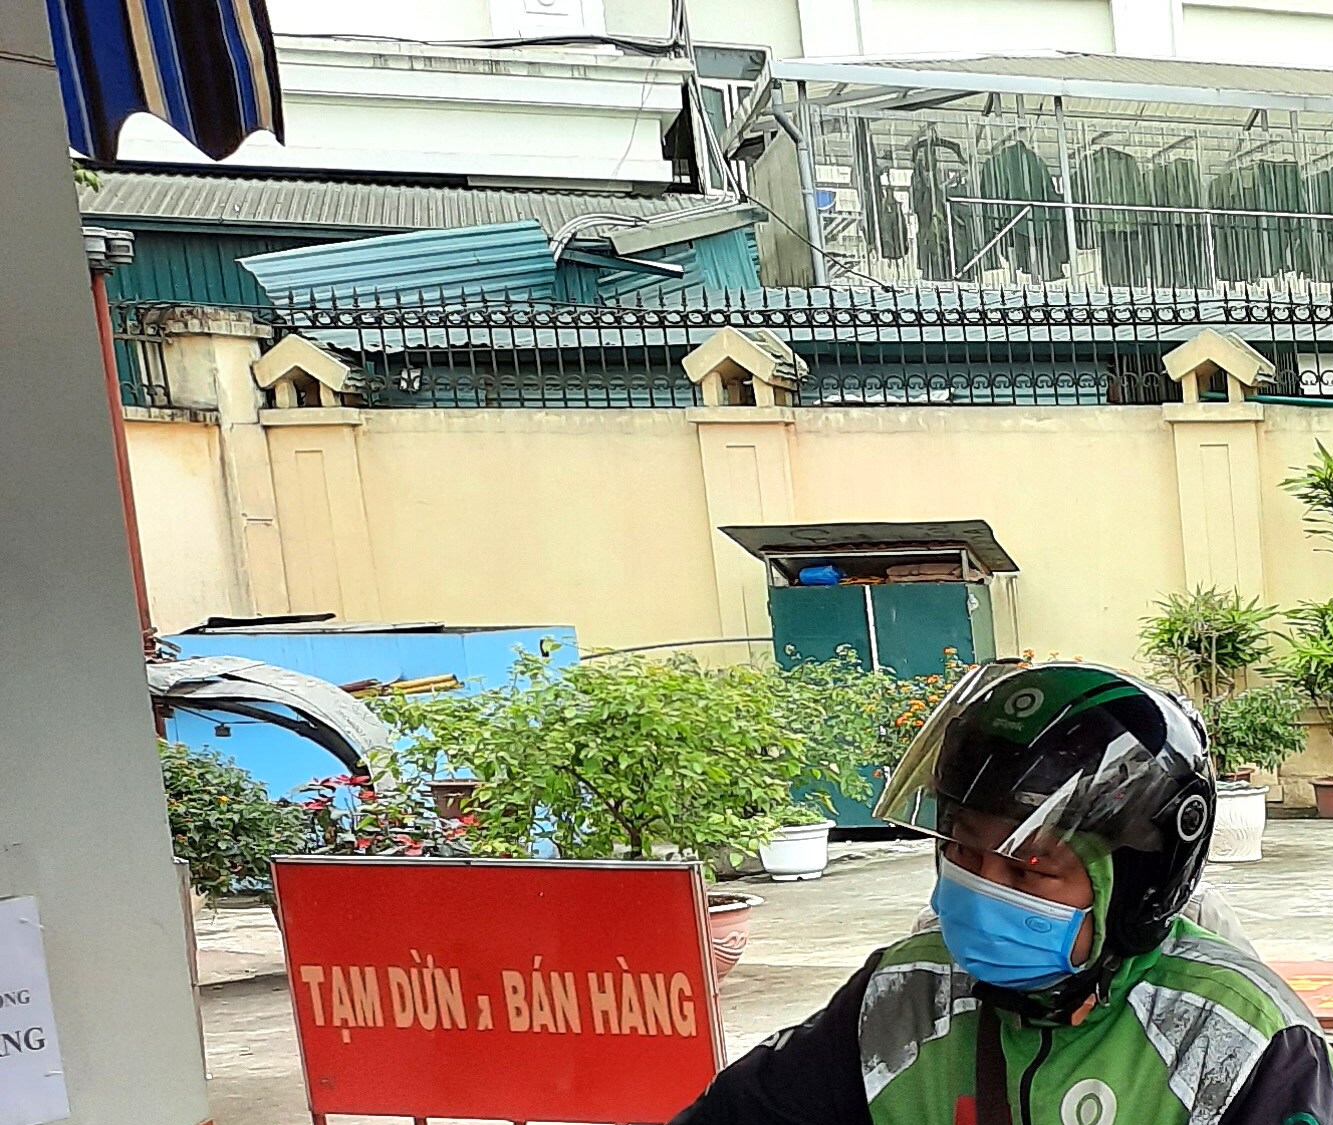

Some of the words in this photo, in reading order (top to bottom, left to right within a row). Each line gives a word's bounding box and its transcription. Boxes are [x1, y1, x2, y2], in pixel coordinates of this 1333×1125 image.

[300, 964, 384, 1044] TẠM
[501, 954, 582, 1034] BÁN
[587, 955, 697, 1037] HÀNG
